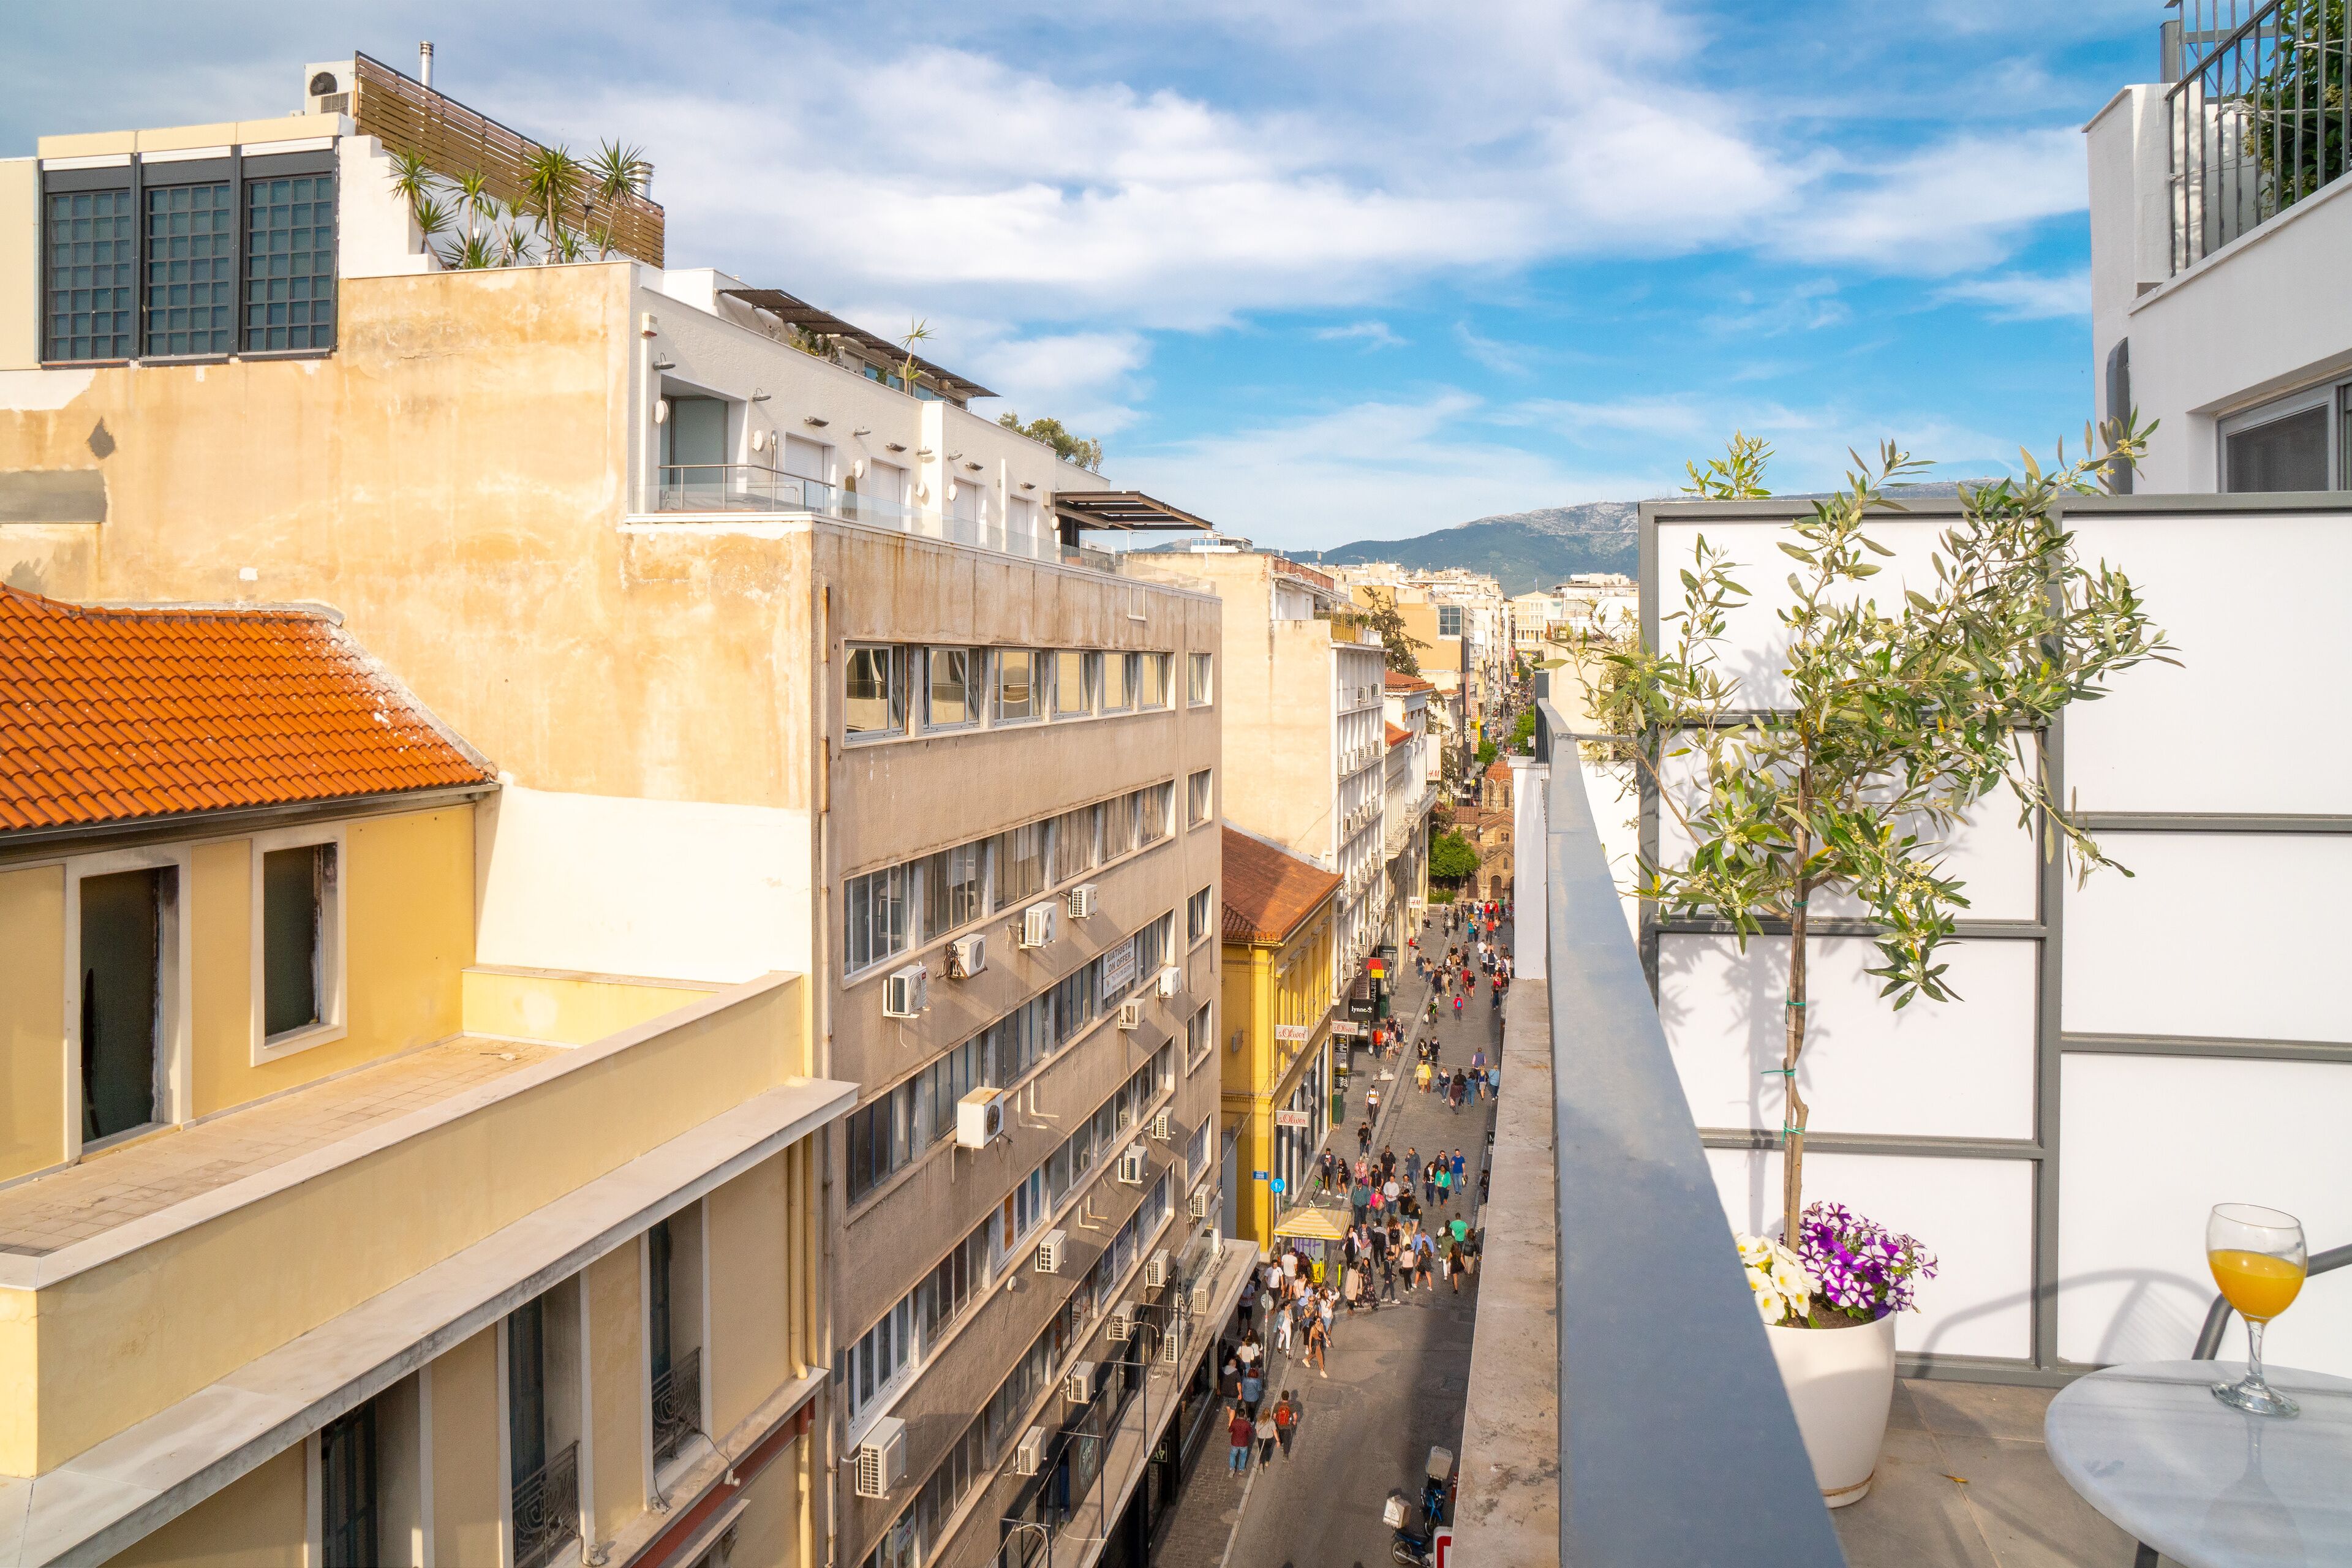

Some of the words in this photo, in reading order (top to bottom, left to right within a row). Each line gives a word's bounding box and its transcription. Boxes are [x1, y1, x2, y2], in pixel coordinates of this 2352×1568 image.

[1107, 940, 1132, 962] ΔΙΑΤΙΘΕΤΑΙ
[1108, 962, 1115, 973] ON
[1116, 951, 1131, 967] OFFER
[1278, 1028, 1305, 1039] s.Oliver
[1333, 1024, 1355, 1033] s.Oliver
[1279, 1114, 1306, 1125] s.Oliver
